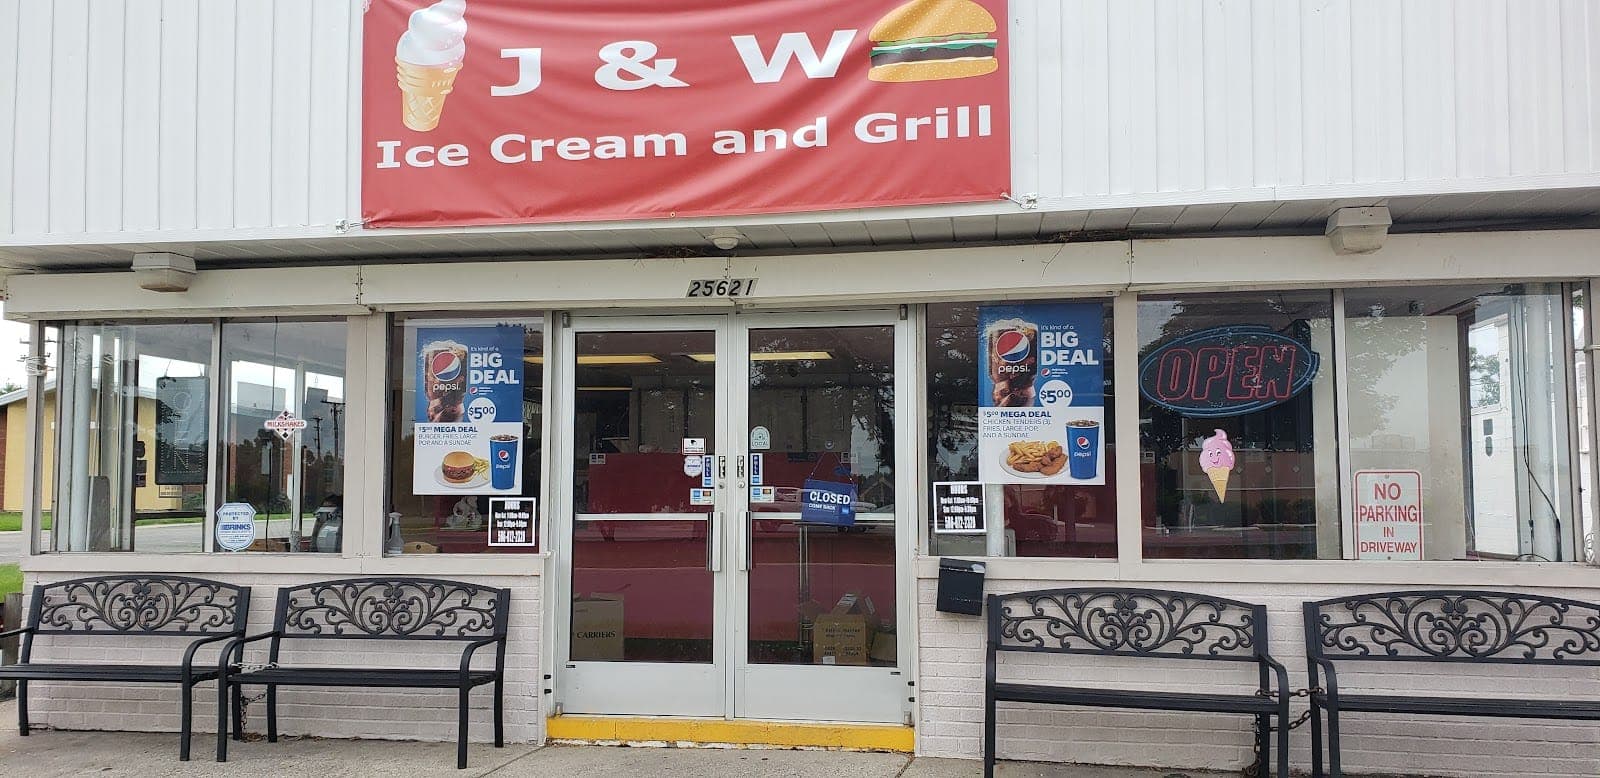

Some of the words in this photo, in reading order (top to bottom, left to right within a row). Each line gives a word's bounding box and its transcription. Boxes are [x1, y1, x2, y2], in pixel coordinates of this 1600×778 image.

[491, 47, 542, 97] J
[594, 40, 690, 91] &
[730, 29, 859, 84] W
[376, 140, 469, 169] Ice
[490, 131, 687, 164] Cream
[711, 115, 828, 156] and
[854, 104, 992, 144] Grill
[687, 279, 754, 298] 25621
[1041, 331, 1079, 348] BIG
[470, 352, 503, 368] BIG
[1041, 349, 1099, 366] DEAL
[998, 363, 1029, 374] pepsi
[1156, 345, 1297, 401] OPEN
[470, 369, 520, 385] DEAL
[433, 382, 459, 393] pepsi
[809, 490, 851, 505] CLOSED
[1374, 482, 1402, 501] NO
[1359, 504, 1418, 522] PARKING
[222, 523, 252, 531] BRINKS
[1383, 526, 1395, 538] IN
[1360, 541, 1418, 553] DRIVEWAY
[576, 630, 617, 639] CARRIERS
